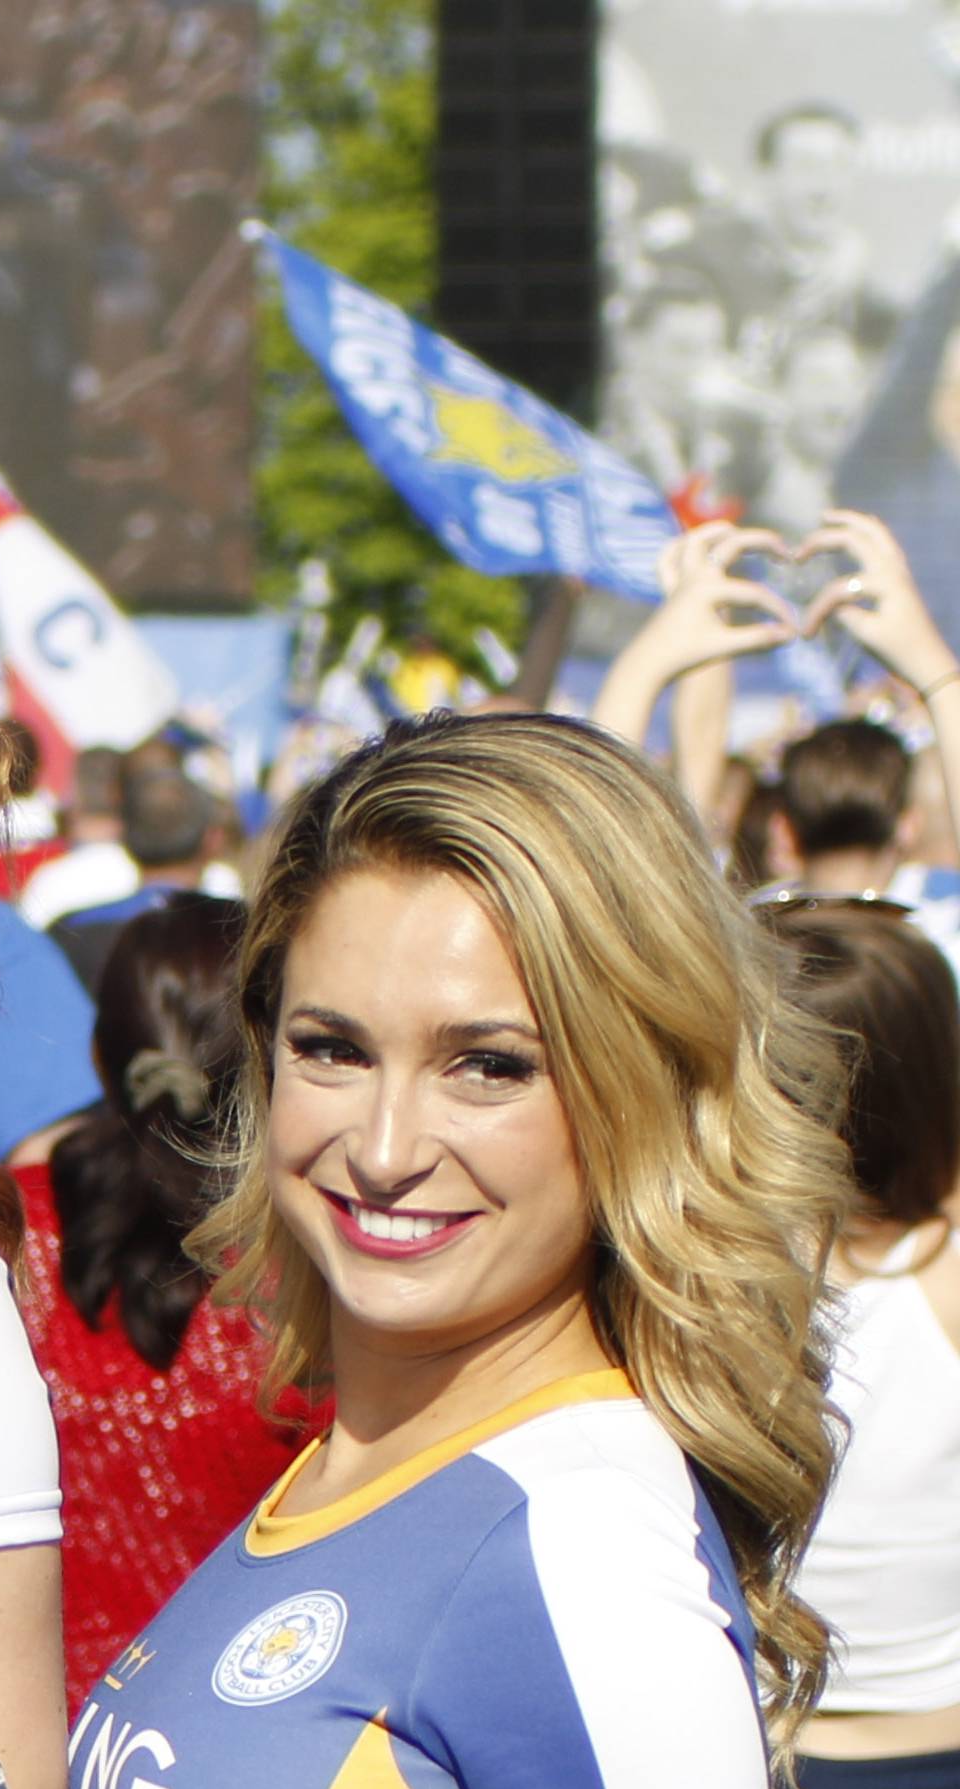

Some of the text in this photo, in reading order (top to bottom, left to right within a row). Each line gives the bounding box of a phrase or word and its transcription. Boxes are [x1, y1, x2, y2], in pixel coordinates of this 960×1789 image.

[249, 1600, 336, 1650] LEICESTER CITY
[223, 1644, 318, 1694] FOOTBALL CLUB
